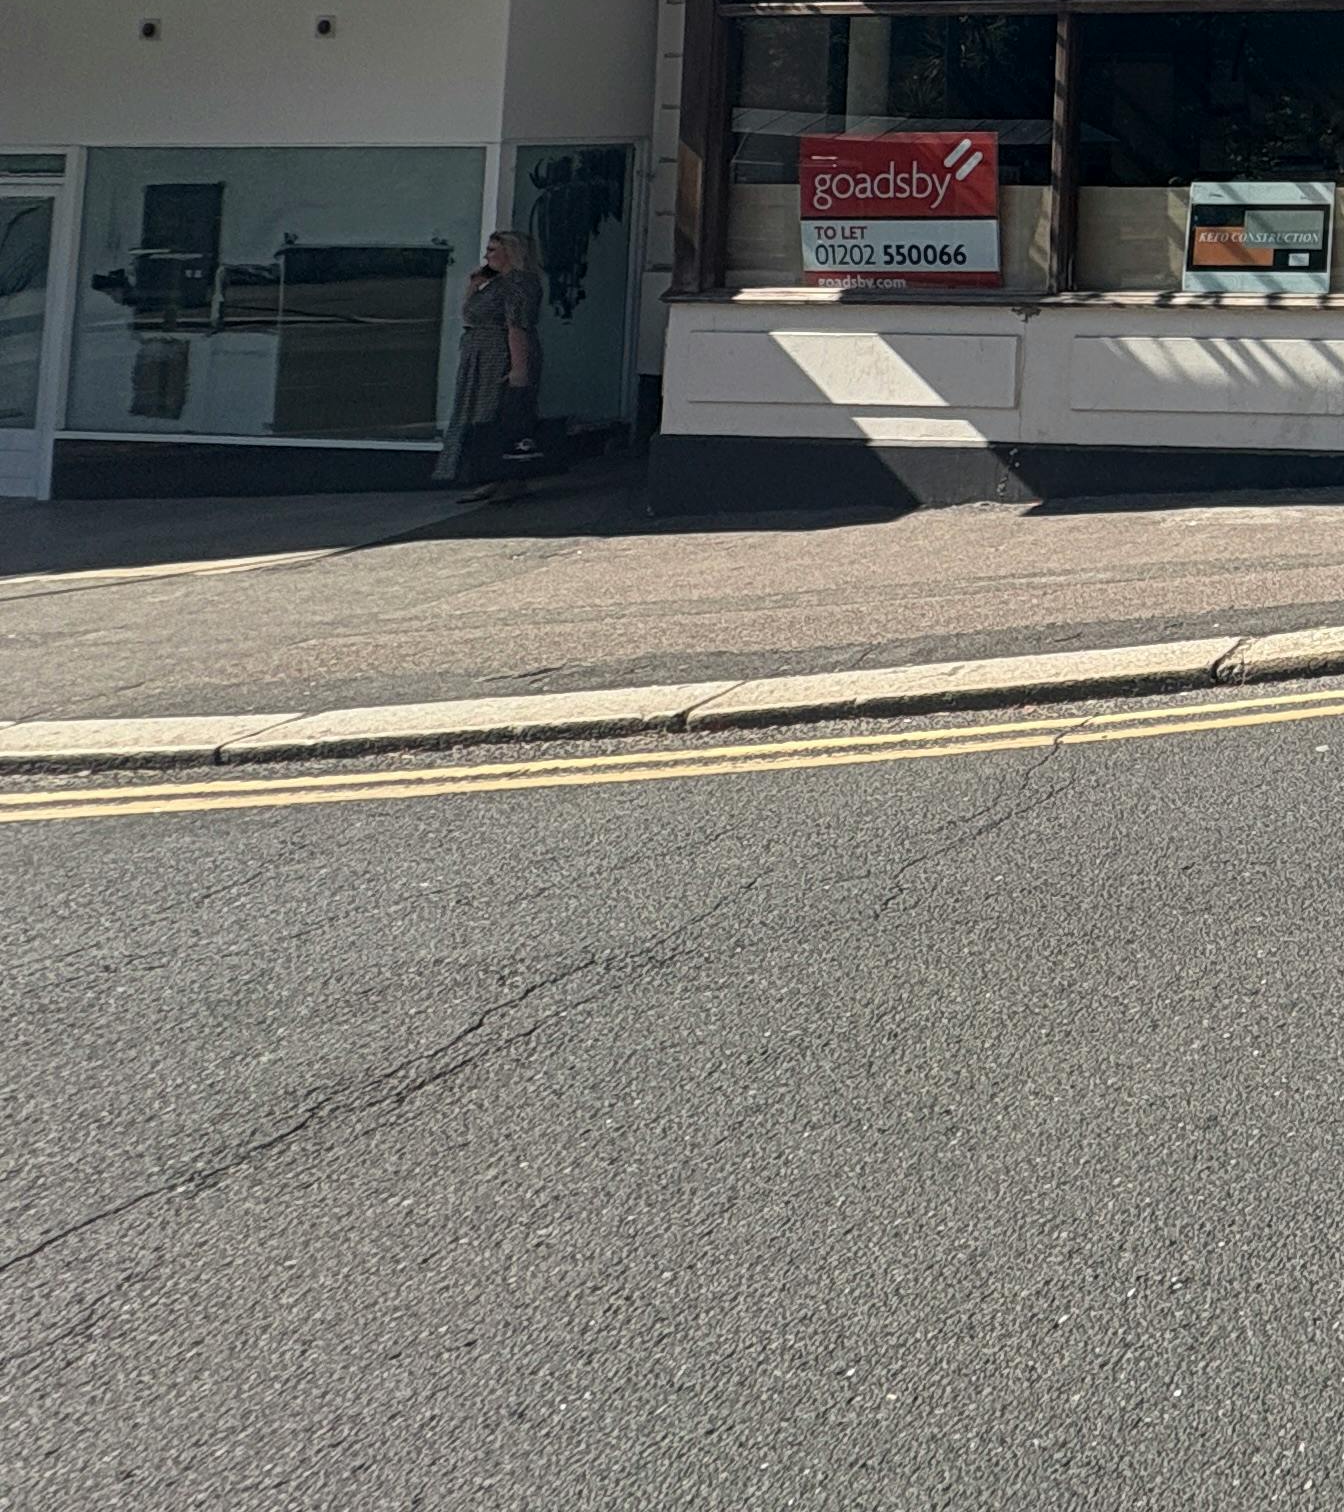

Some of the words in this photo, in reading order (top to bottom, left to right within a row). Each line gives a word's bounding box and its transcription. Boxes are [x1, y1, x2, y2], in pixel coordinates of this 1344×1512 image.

[813, 160, 952, 210] goadsby
[814, 226, 837, 240] TO
[841, 226, 868, 240] LET
[1230, 232, 1320, 244] CONSTRUCTION
[815, 244, 876, 266] 01202
[883, 244, 968, 266] 550066
[818, 274, 907, 288] goadsby.com
